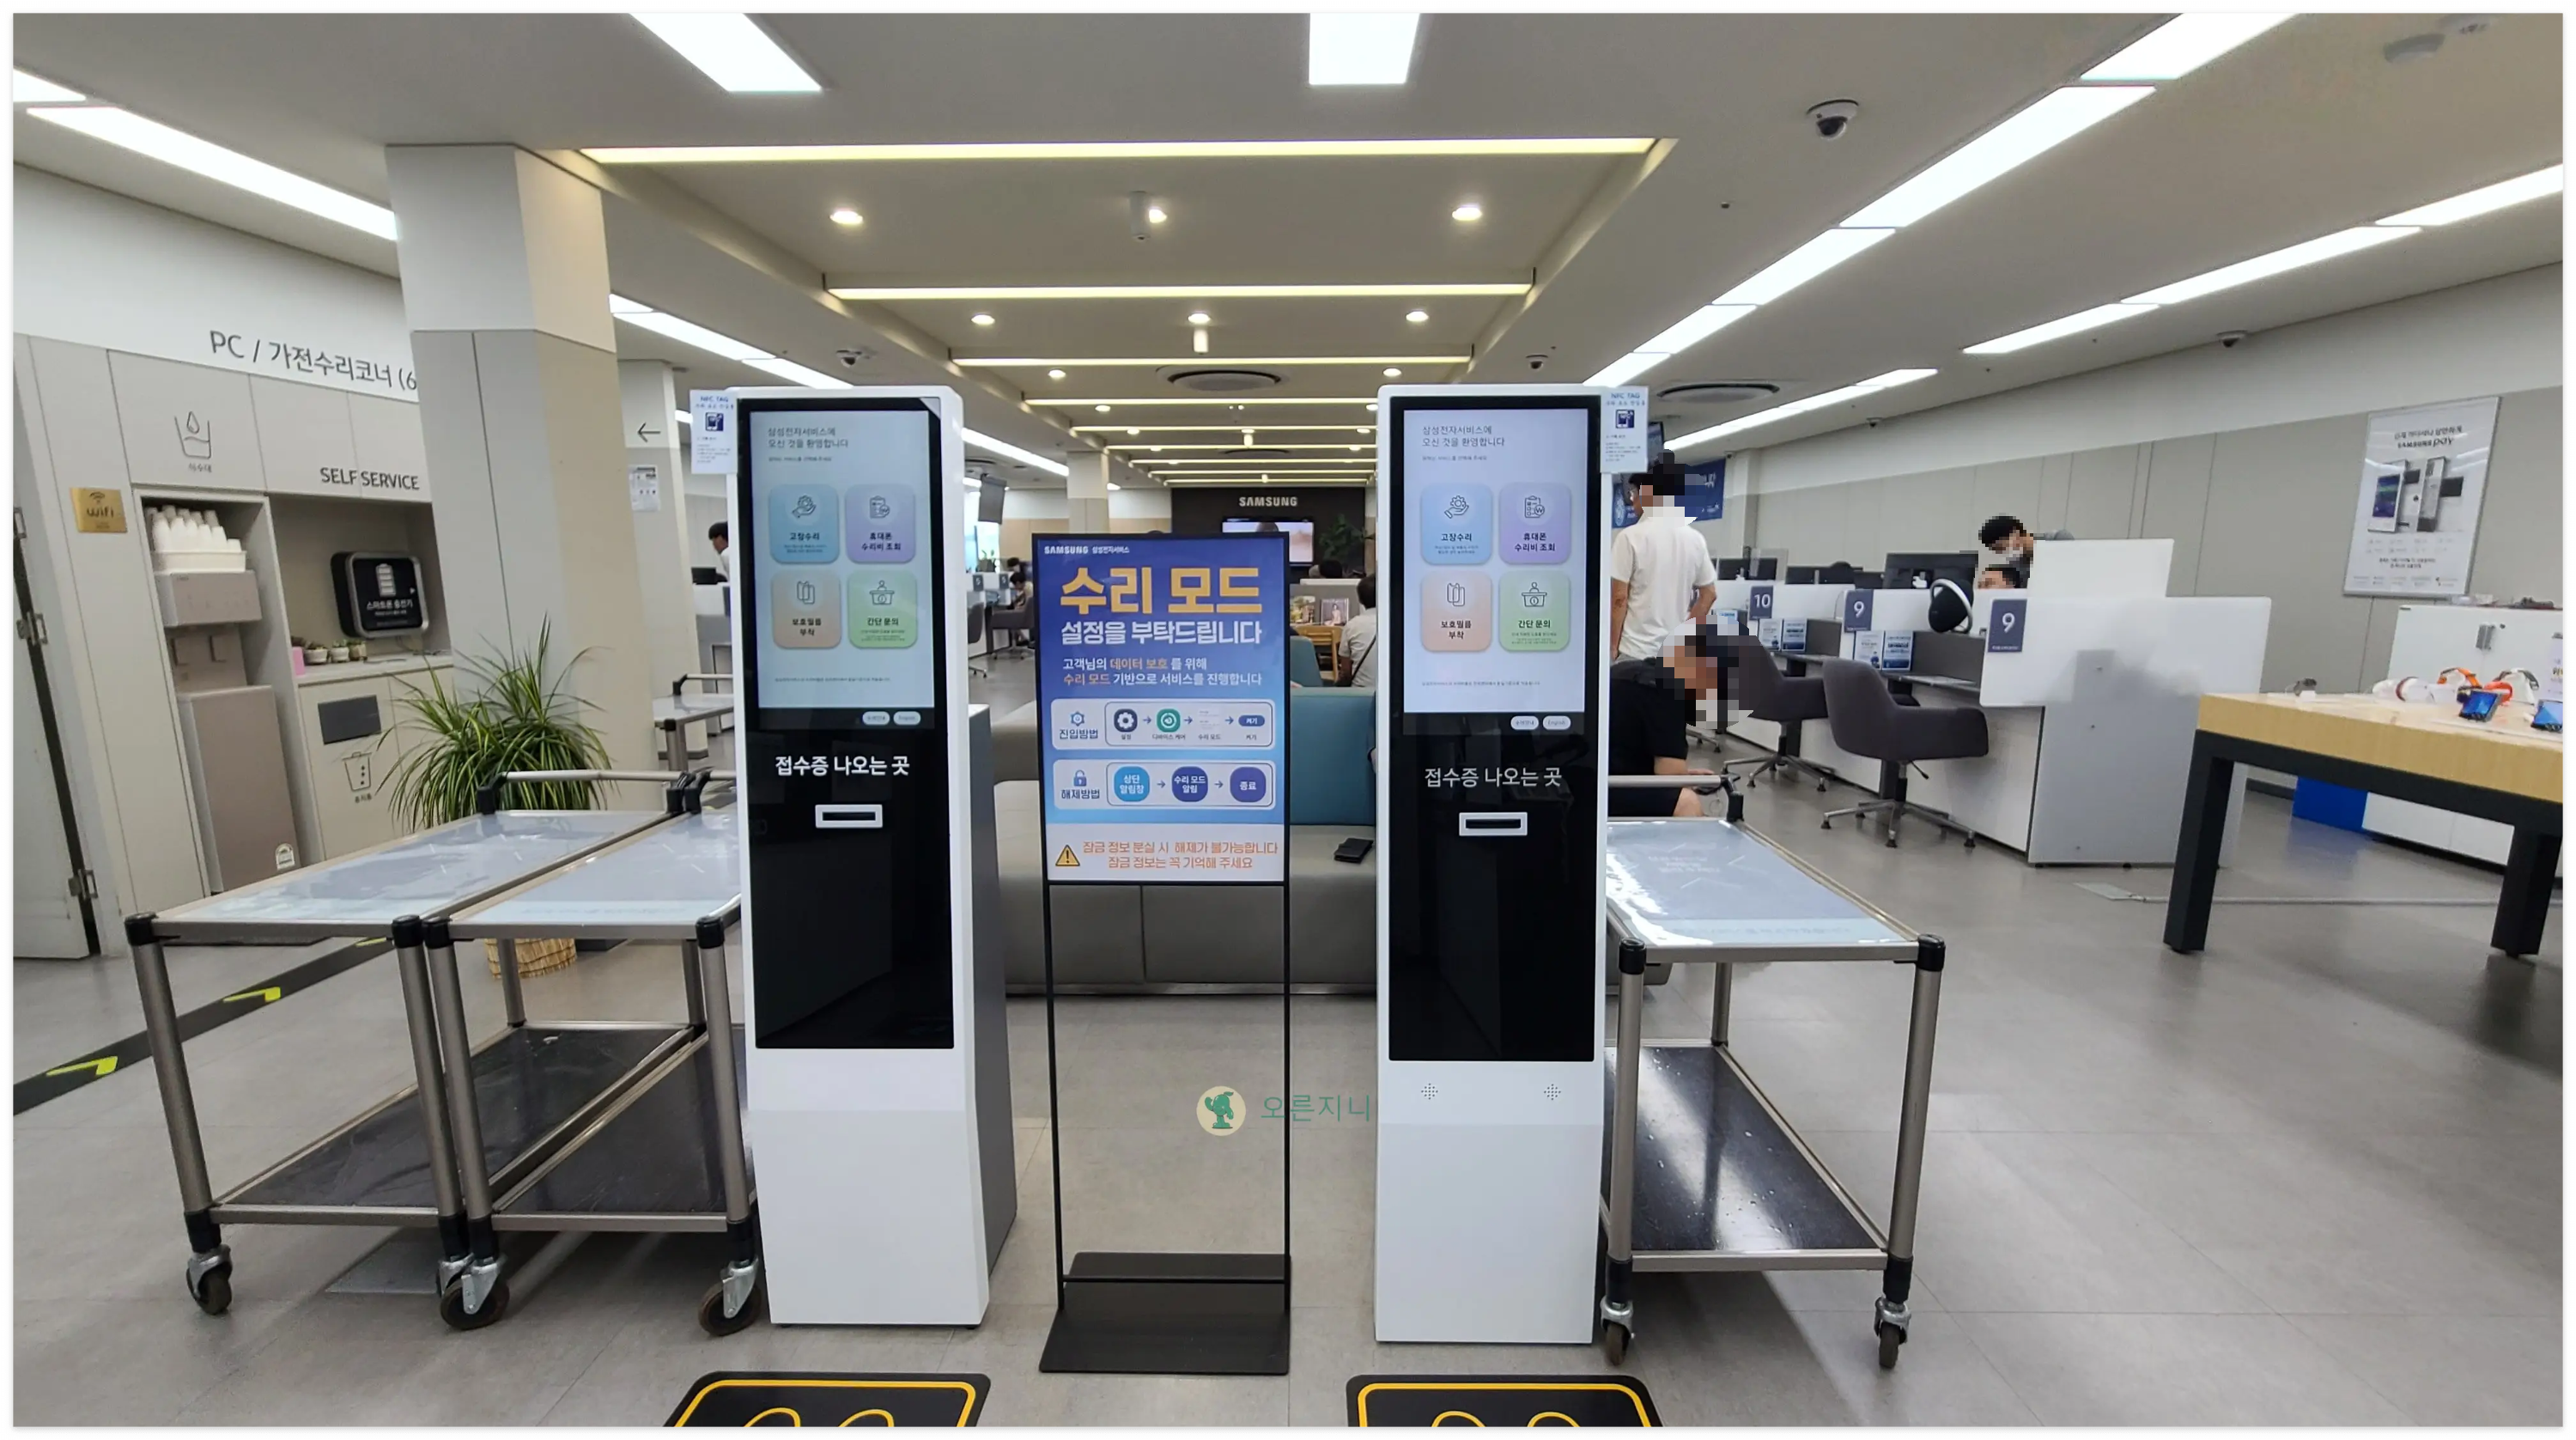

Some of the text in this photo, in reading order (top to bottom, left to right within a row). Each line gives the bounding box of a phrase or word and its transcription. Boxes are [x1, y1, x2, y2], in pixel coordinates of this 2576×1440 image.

[210, 330, 245, 358] PC
[252, 339, 260, 363] /
[269, 341, 392, 388] 가전수리코너
[1422, 425, 1492, 435] 삼성전자서비스에
[1422, 437, 1505, 447] 오신 것을 환영합니다
[319, 467, 420, 491] SELF SERVICE
[1239, 496, 1297, 507] SAMSUNG
[1441, 533, 1473, 542] 고장수리
[1523, 532, 1547, 541] 휴대폰
[1044, 545, 1089, 554] SAMSUNG
[1514, 543, 1556, 552] 수리비 조회
[1060, 567, 1262, 615] 수리 모드
[1754, 593, 1771, 608] 10
[1854, 601, 1864, 618] 9
[866, 617, 882, 626] 간단
[1518, 619, 1551, 629] 간단 문의
[2002, 612, 2015, 634] 9
[1061, 621, 1262, 645] 설정을 부탁드립니다
[1449, 630, 1464, 640] 부착
[1062, 658, 1207, 671] 고객님의 데이터 보호 를 위해
[1063, 672, 1262, 686] 수리 모드 기반으로 서비스를 진행합니다
[1059, 729, 1099, 739] 진입방법
[775, 756, 910, 776] 접수증 나오는 곳
[1123, 775, 1140, 784] 상단
[1174, 775, 1189, 784] 수리
[1425, 767, 1562, 788] 접수증 나오는 곳
[1119, 784, 1145, 794] 알림창
[1182, 784, 1198, 793] 알림
[1239, 781, 1257, 791] 종료
[1061, 789, 1100, 799] 해제방법
[1083, 842, 1278, 854] 잠금 정보 분실 시 해제가 불가능합니다
[1109, 856, 1253, 869] 잠금 정보는 꼭 기억해 주세요
